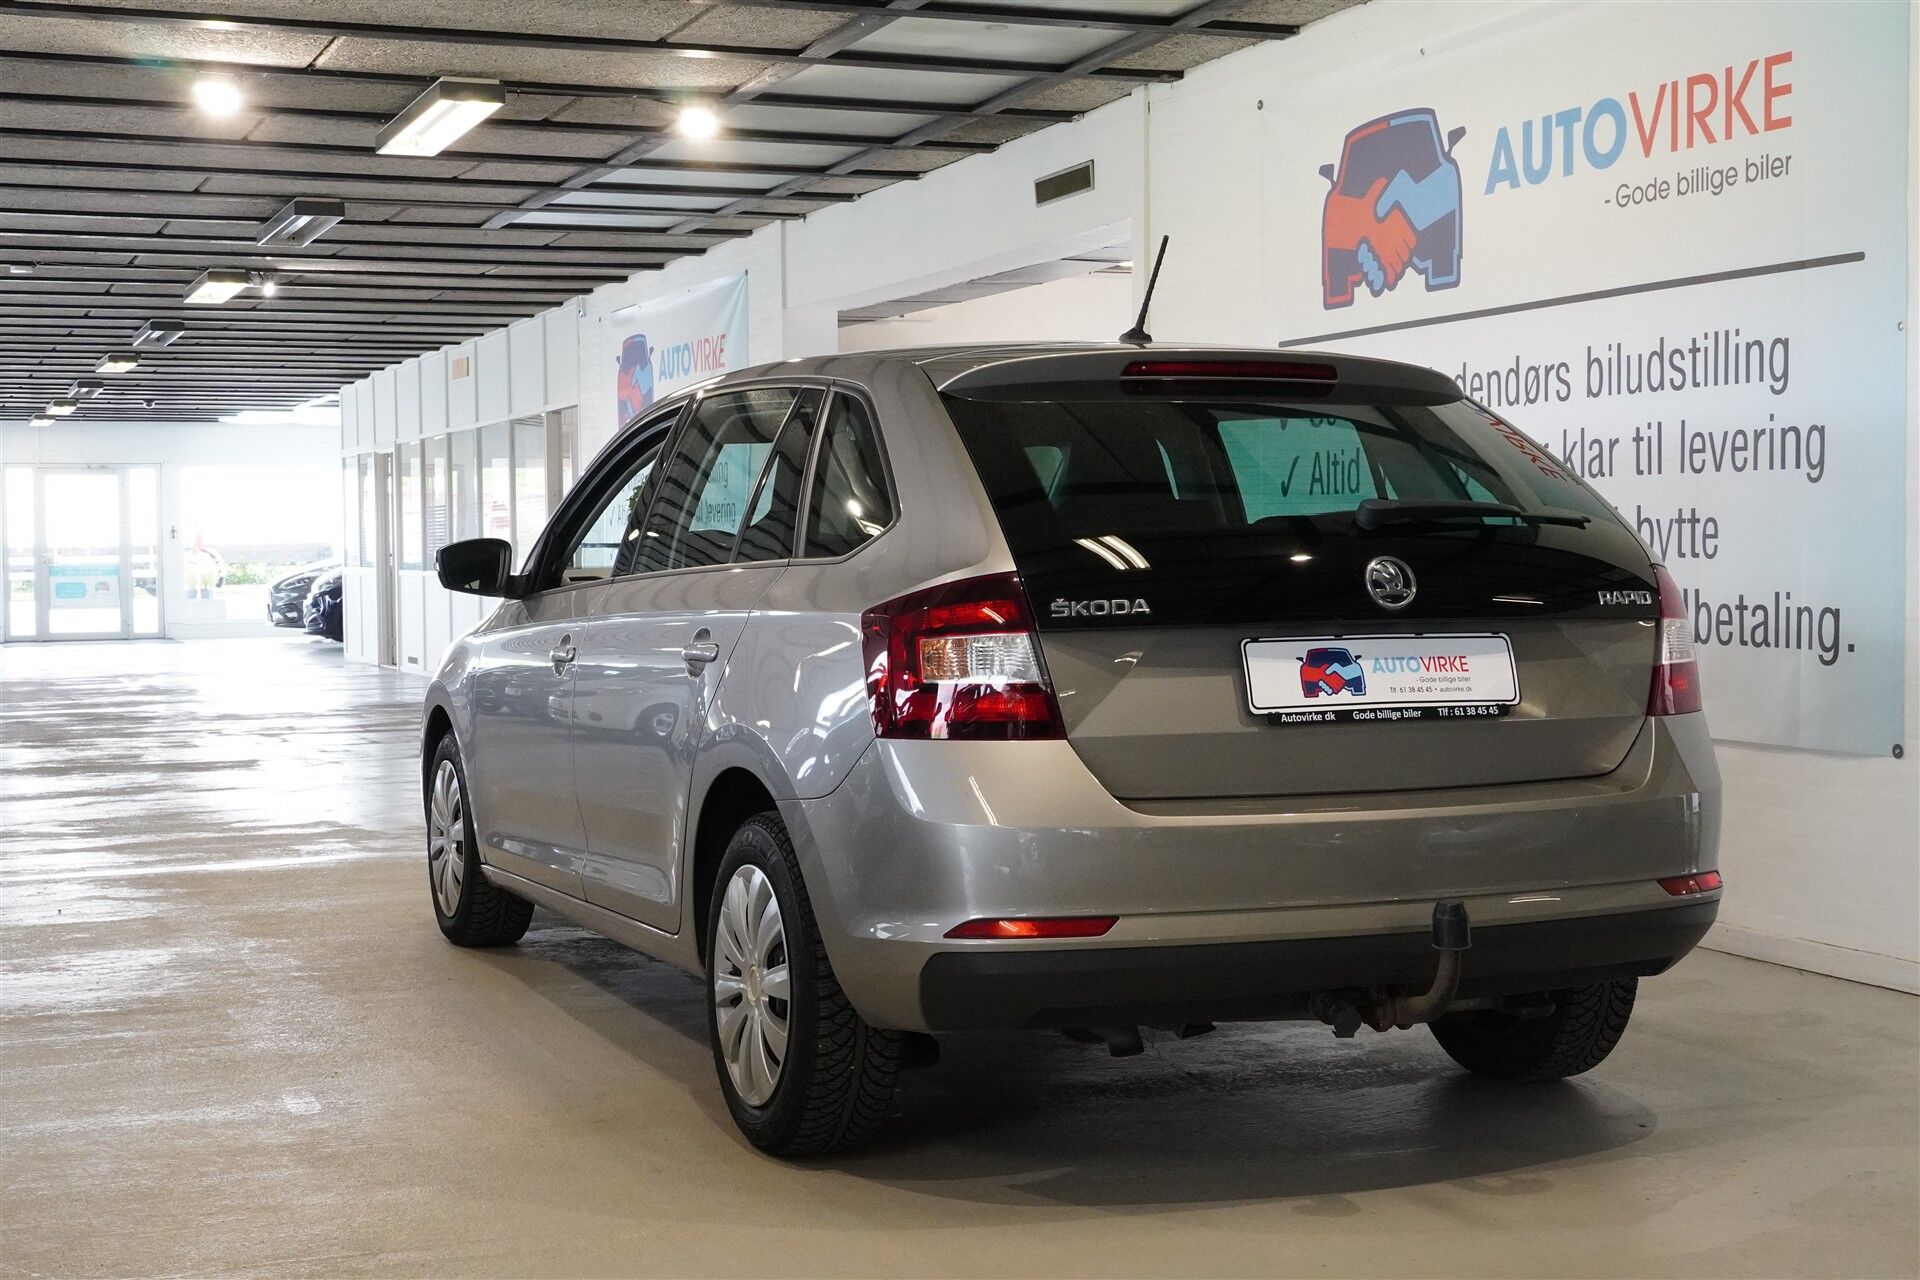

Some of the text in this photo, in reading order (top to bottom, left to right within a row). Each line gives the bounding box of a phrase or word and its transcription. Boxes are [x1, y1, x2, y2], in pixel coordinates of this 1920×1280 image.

[1484, 51, 1793, 196] AUTOVIRKE
[1615, 177, 1670, 208] Gode
[1676, 166, 1738, 196] billige
[1745, 154, 1792, 184] biler
[658, 333, 726, 382] AUTOVIRKE
[1453, 328, 1790, 408] dendørs biludstilling
[1309, 447, 1361, 496] Altid
[1562, 413, 1826, 484] klar til levering
[1051, 598, 1151, 617] ŠKODA
[1598, 590, 1653, 605] RAPID
[1372, 656, 1470, 674] AUTOVIRKE
[1438, 676, 1457, 684] billige
[1353, 711, 1375, 720] Gode
[1377, 709, 1402, 720] billige
[1403, 709, 1422, 718] biler
[1454, 707, 1465, 716] 61
[1466, 707, 1476, 715] 38
[1477, 706, 1487, 715] 45
[1488, 706, 1499, 714] 45
